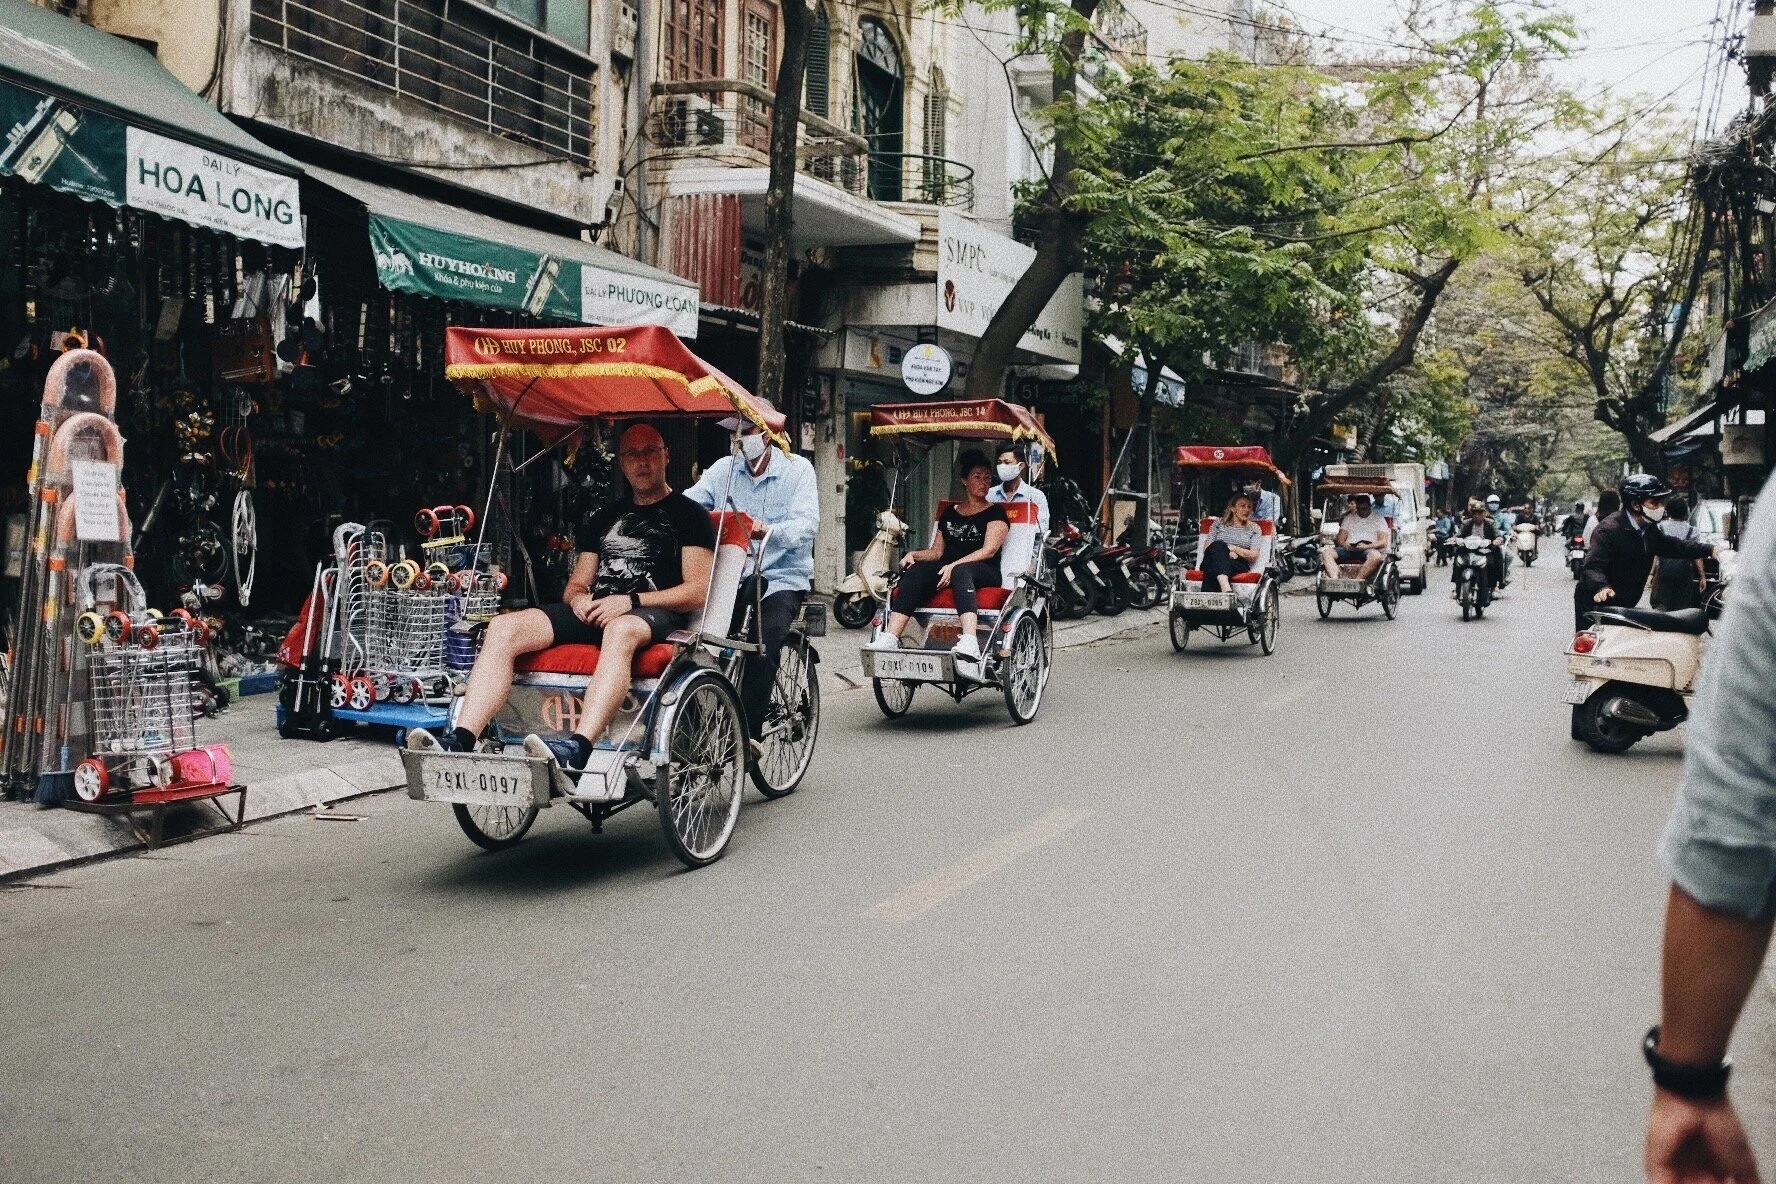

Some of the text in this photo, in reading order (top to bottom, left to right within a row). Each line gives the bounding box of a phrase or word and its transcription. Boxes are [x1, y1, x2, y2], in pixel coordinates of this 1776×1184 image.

[138, 157, 293, 225] HOA LONG
[501, 339, 526, 354] HUY
[579, 337, 603, 354] JSC
[606, 336, 627, 353] 02
[1022, 383, 1039, 400] 51
[912, 408, 928, 419] HUY
[975, 406, 986, 416] 14
